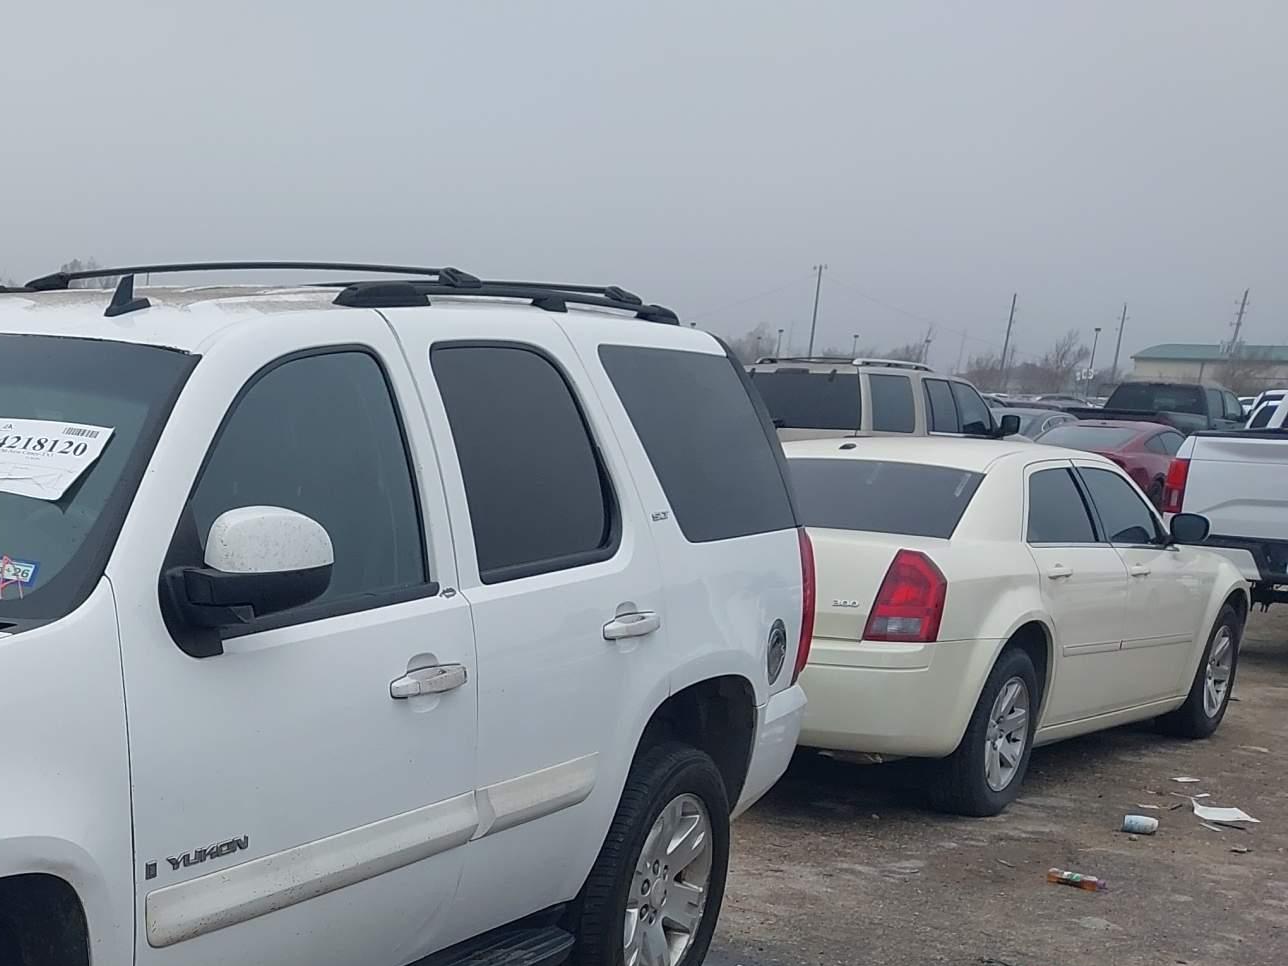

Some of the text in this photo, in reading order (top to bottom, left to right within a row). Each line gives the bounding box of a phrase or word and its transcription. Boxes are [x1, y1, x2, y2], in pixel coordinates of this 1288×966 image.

[12, 567, 31, 578] 26
[832, 599, 860, 608] 300
[166, 834, 249, 871] YUKON
